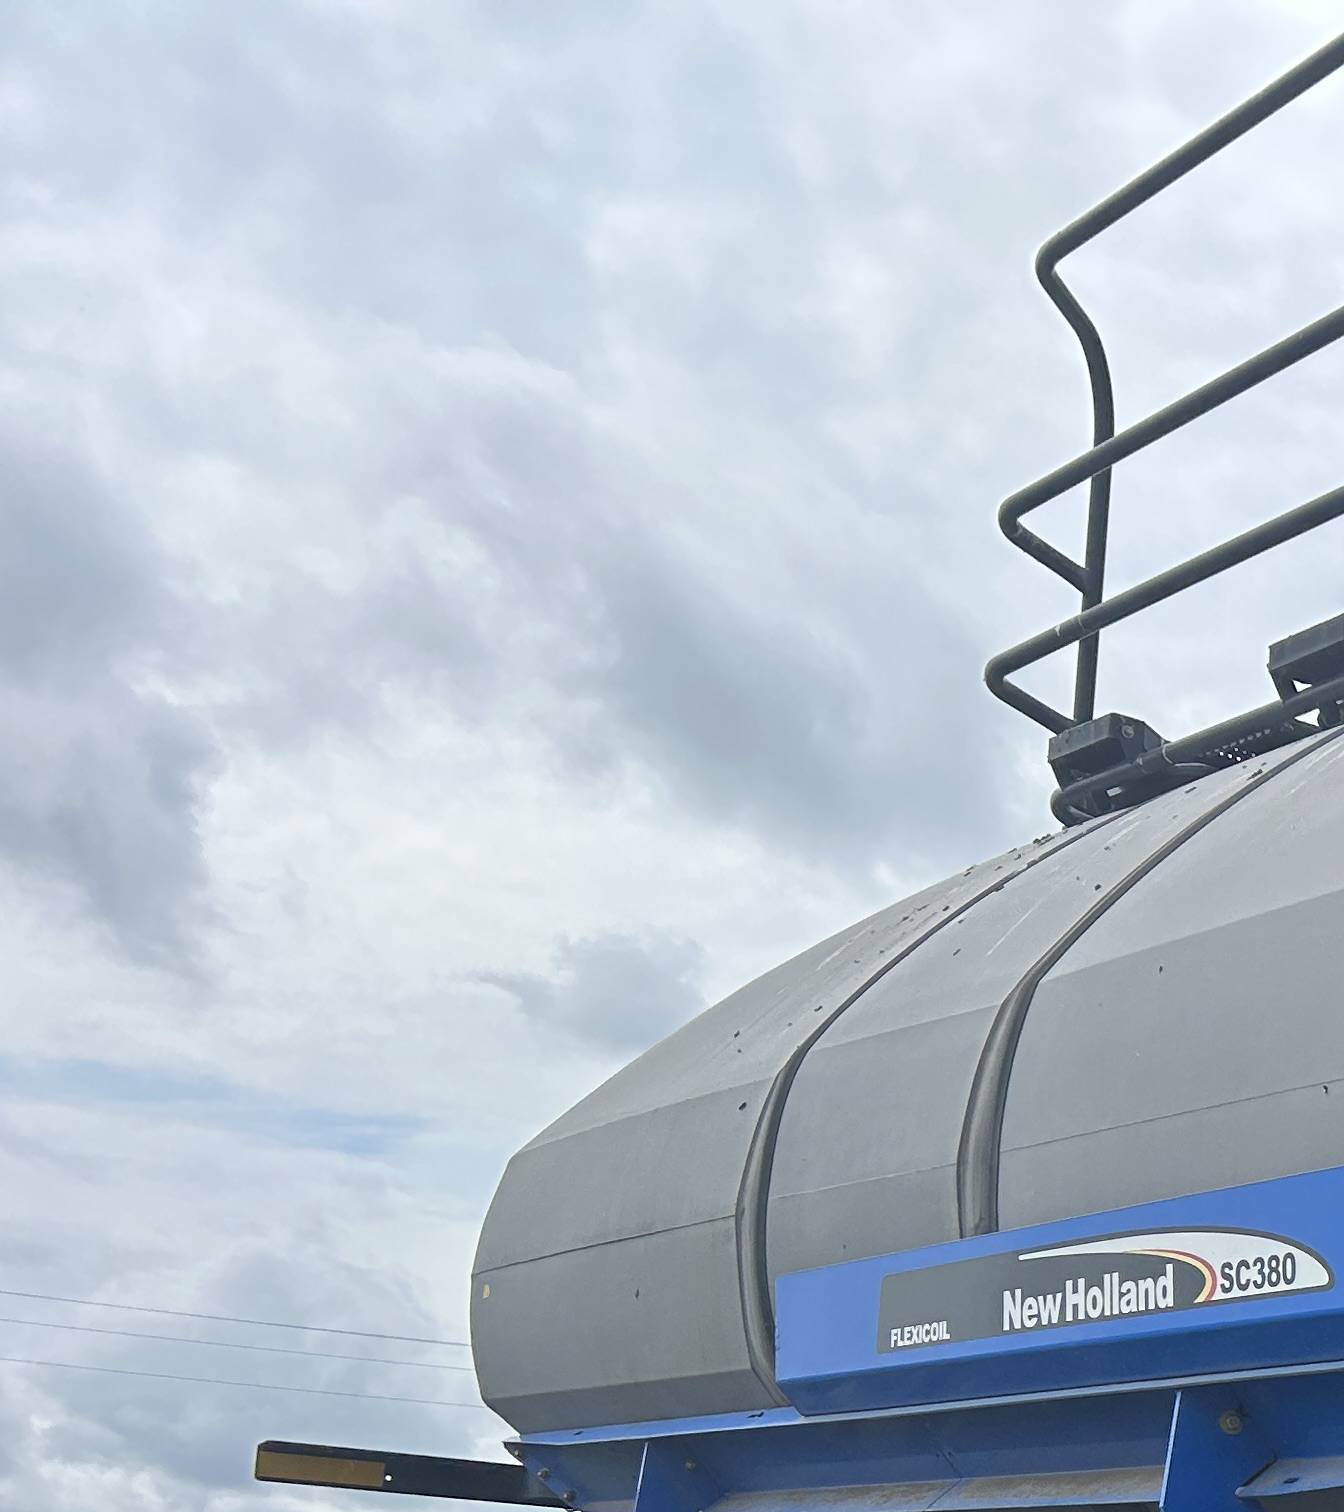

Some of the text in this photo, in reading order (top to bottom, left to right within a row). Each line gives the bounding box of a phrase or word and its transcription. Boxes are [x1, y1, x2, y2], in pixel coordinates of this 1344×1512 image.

[1220, 1252, 1296, 1294] SC380
[1002, 1263, 1174, 1331] New Holland
[890, 1320, 951, 1348] FLEXICOIL
